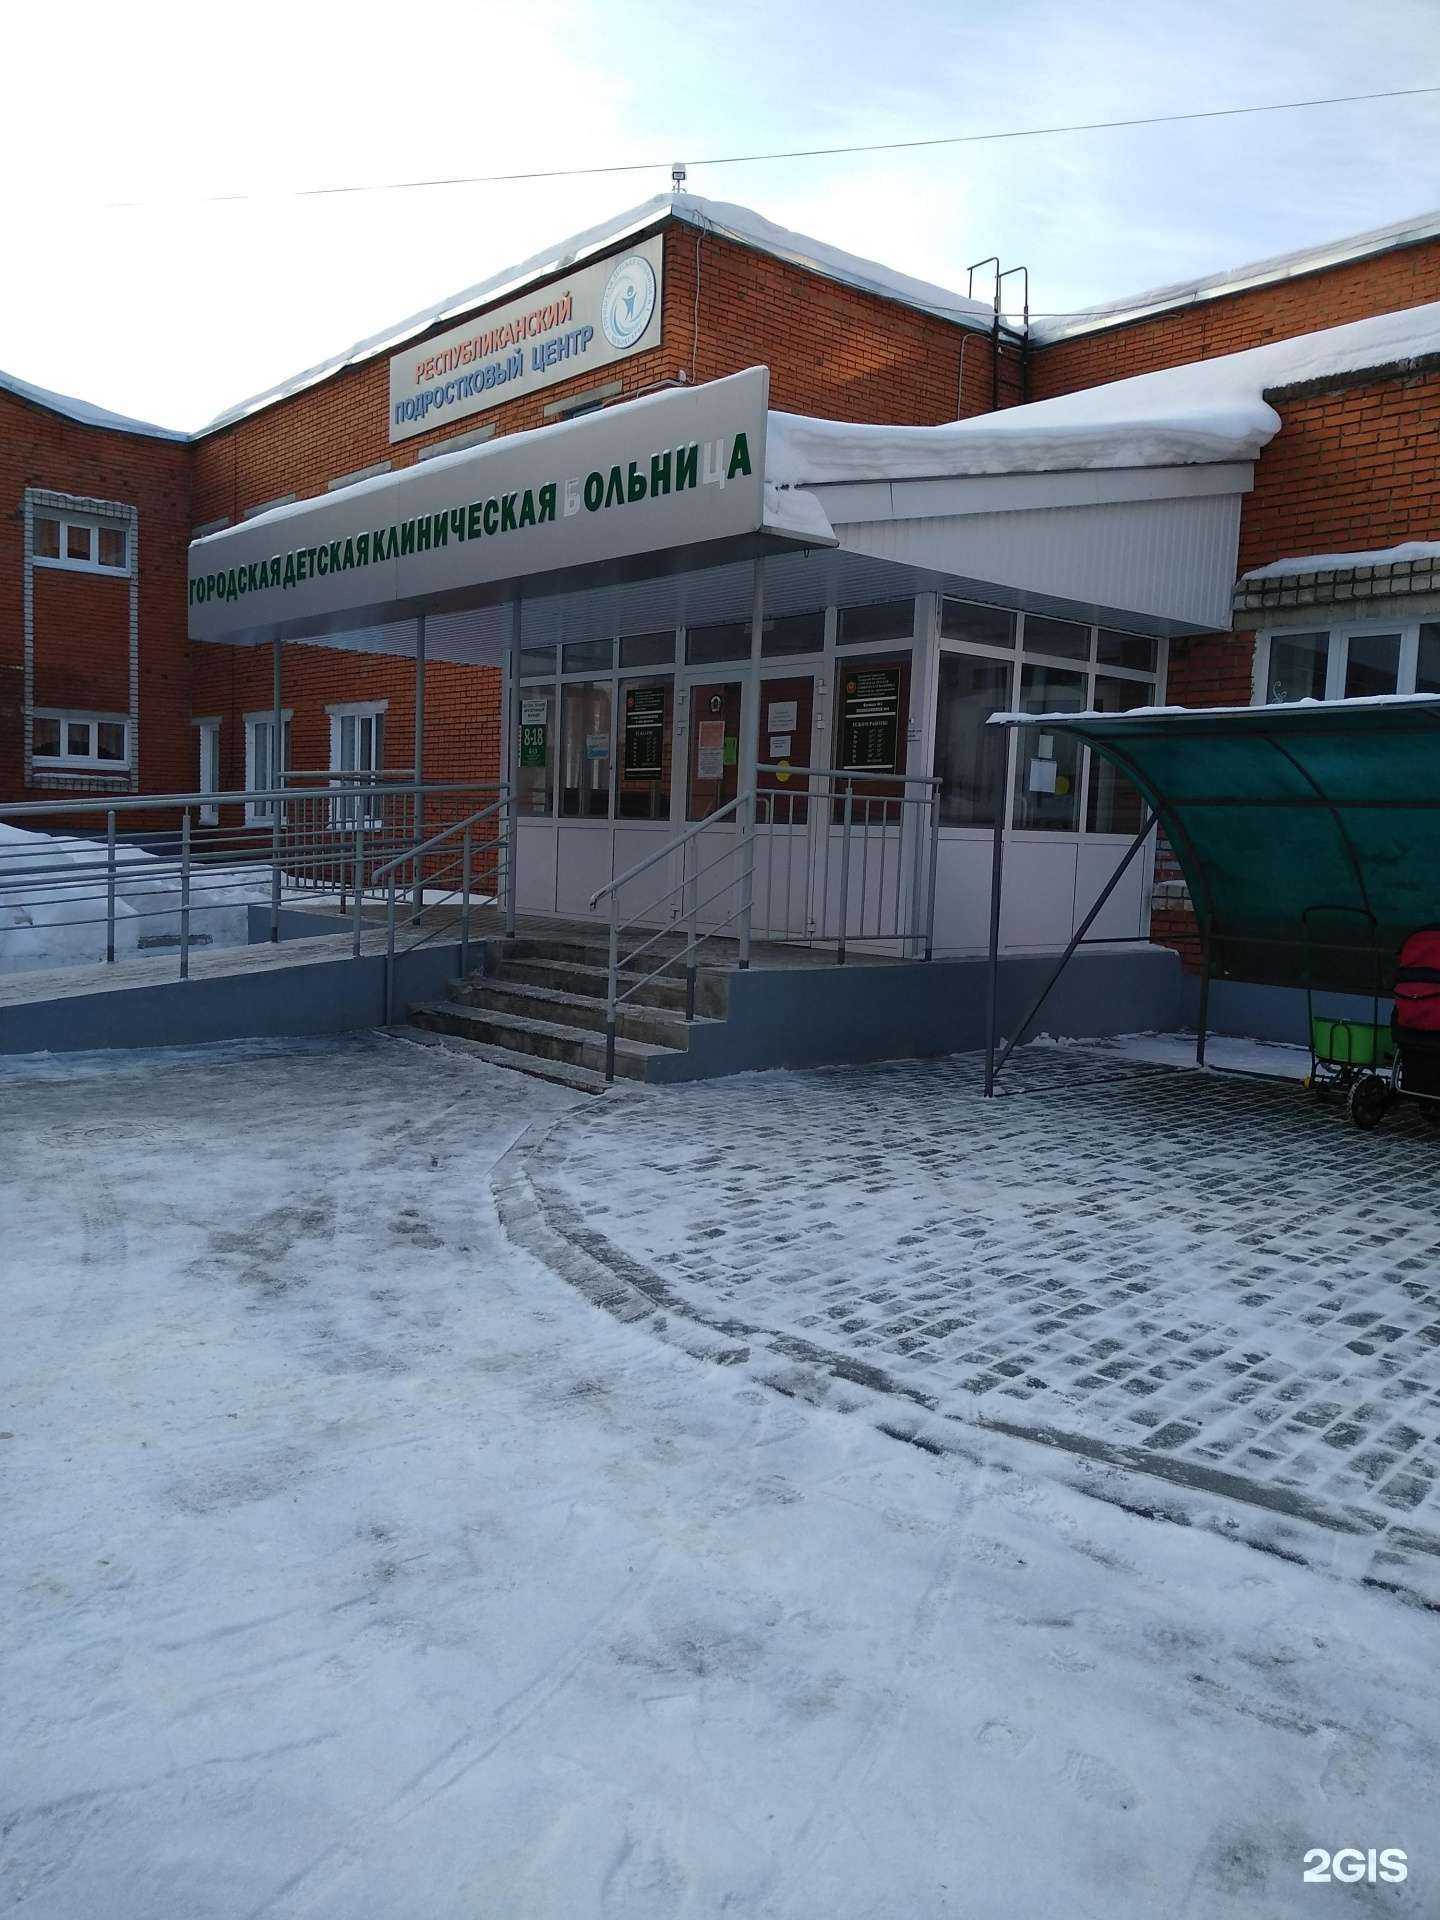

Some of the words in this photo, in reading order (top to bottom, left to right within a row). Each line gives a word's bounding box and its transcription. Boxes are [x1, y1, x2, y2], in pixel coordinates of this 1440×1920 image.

[394, 347, 524, 425] ПОДРОСТКОВЫЙ
[531, 325, 594, 373] ЦЕНТР
[415, 290, 573, 384] РЕСПУБЛИКАНСКИЙ
[189, 555, 281, 605] ГОРОДСКАЯ
[282, 531, 370, 590] ДЕТСКАЯ
[372, 481, 557, 563] КЛИНИЧЕСКАЯ
[563, 432, 752, 517] БОЛЬНИЦА
